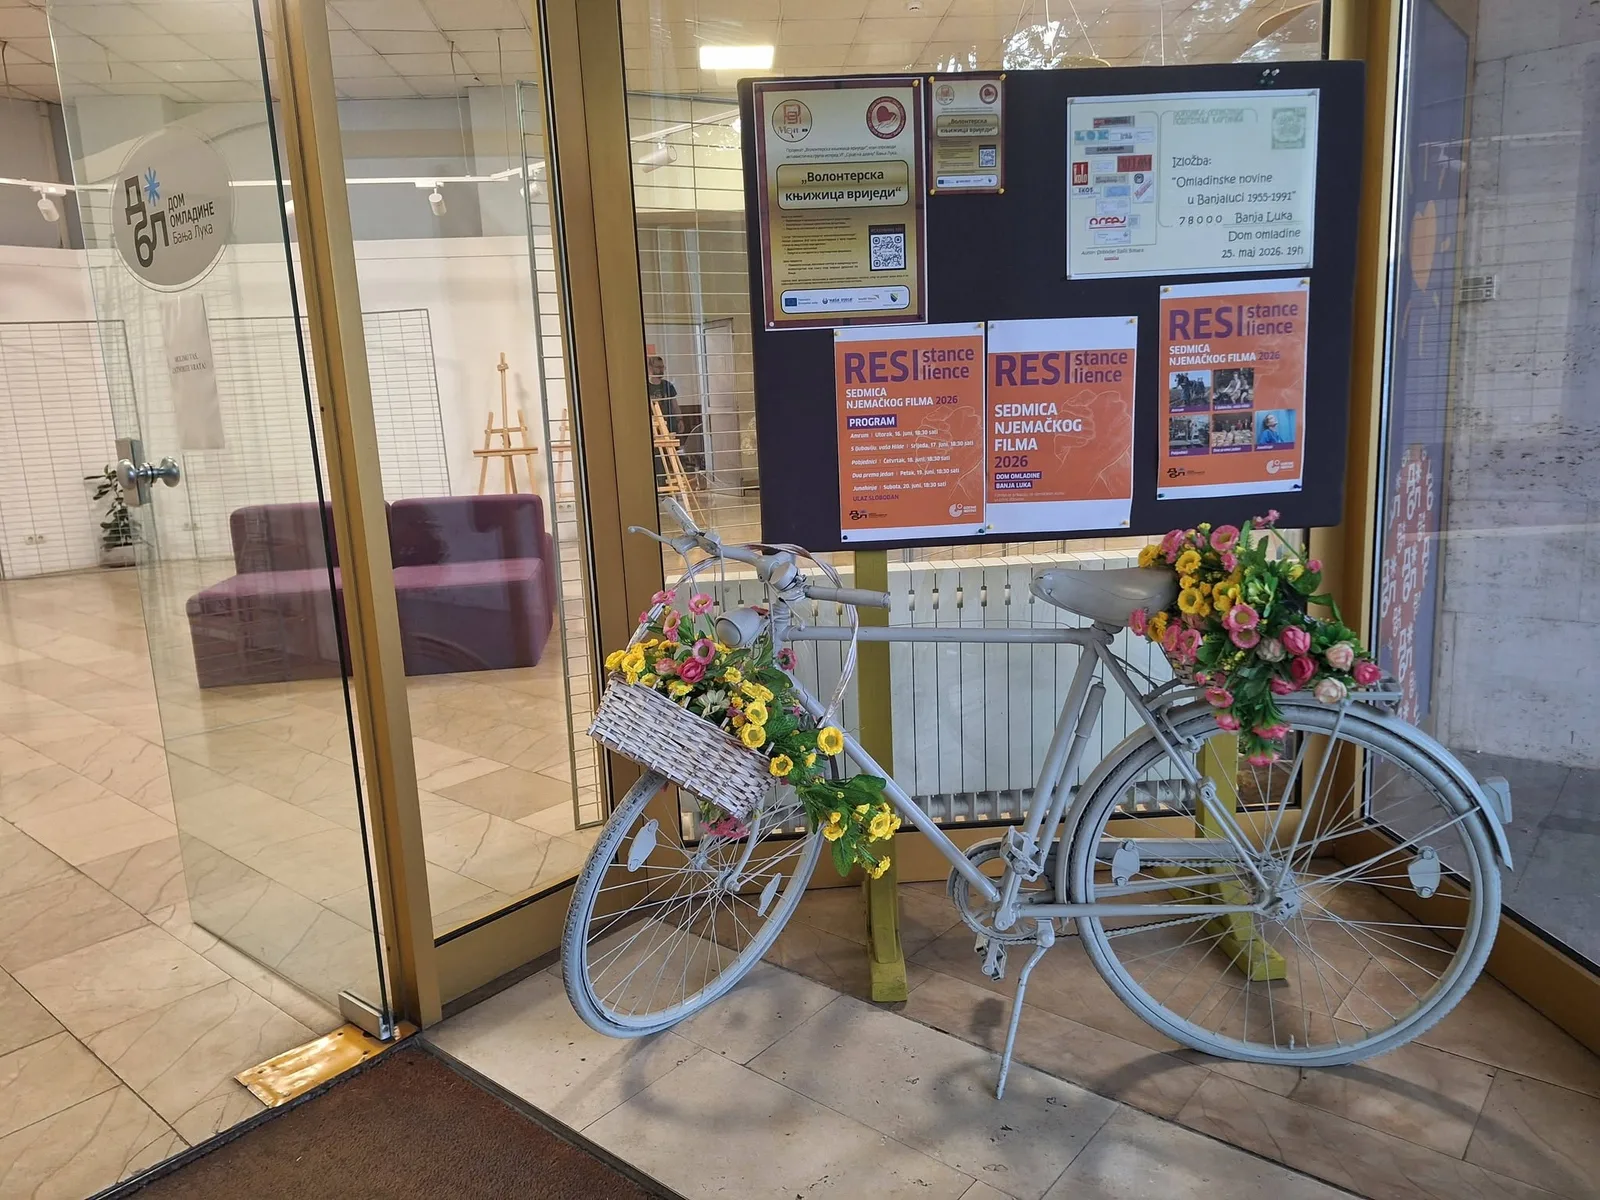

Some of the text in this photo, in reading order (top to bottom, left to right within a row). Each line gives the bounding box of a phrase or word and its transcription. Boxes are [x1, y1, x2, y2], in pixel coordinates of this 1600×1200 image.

[1172, 154, 1212, 168] Izložba:
[801, 171, 884, 184] „Волонтерска
[1172, 173, 1273, 188] "Omladinske novine
[785, 186, 901, 202] књижица вриједи“
[1197, 192, 1245, 206] Banjaluci
[1248, 190, 1296, 202] 1955-1991"
[168, 193, 185, 213] ДОМ
[170, 202, 214, 227] ОМЛАДИНЕ
[1236, 212, 1263, 224] Banja
[1266, 211, 1293, 223] Luka
[173, 223, 214, 245] Бања Лука
[1229, 228, 1301, 242] Dom omladine
[1222, 246, 1304, 258] 25. maj 2026. 19h
[1247, 303, 1298, 318] stance
[1247, 321, 1293, 336] lience
[923, 348, 975, 362] stance
[1169, 344, 1210, 354] SEDMICA
[1075, 351, 1128, 366] stance
[1169, 350, 1280, 366] NJEMAČKOG FILMA 2026
[922, 365, 969, 380] lience
[1074, 369, 1122, 383] lience
[846, 388, 887, 398] SEDMICA
[846, 396, 958, 409] NJEMAČKOG FILMA 2026
[995, 403, 1057, 417] SEDMICA
[849, 417, 895, 427] PROGRAM
[995, 418, 1082, 434] NJEMAČKOG
[995, 438, 1038, 451] FILMA
[995, 455, 1028, 468] 2026
